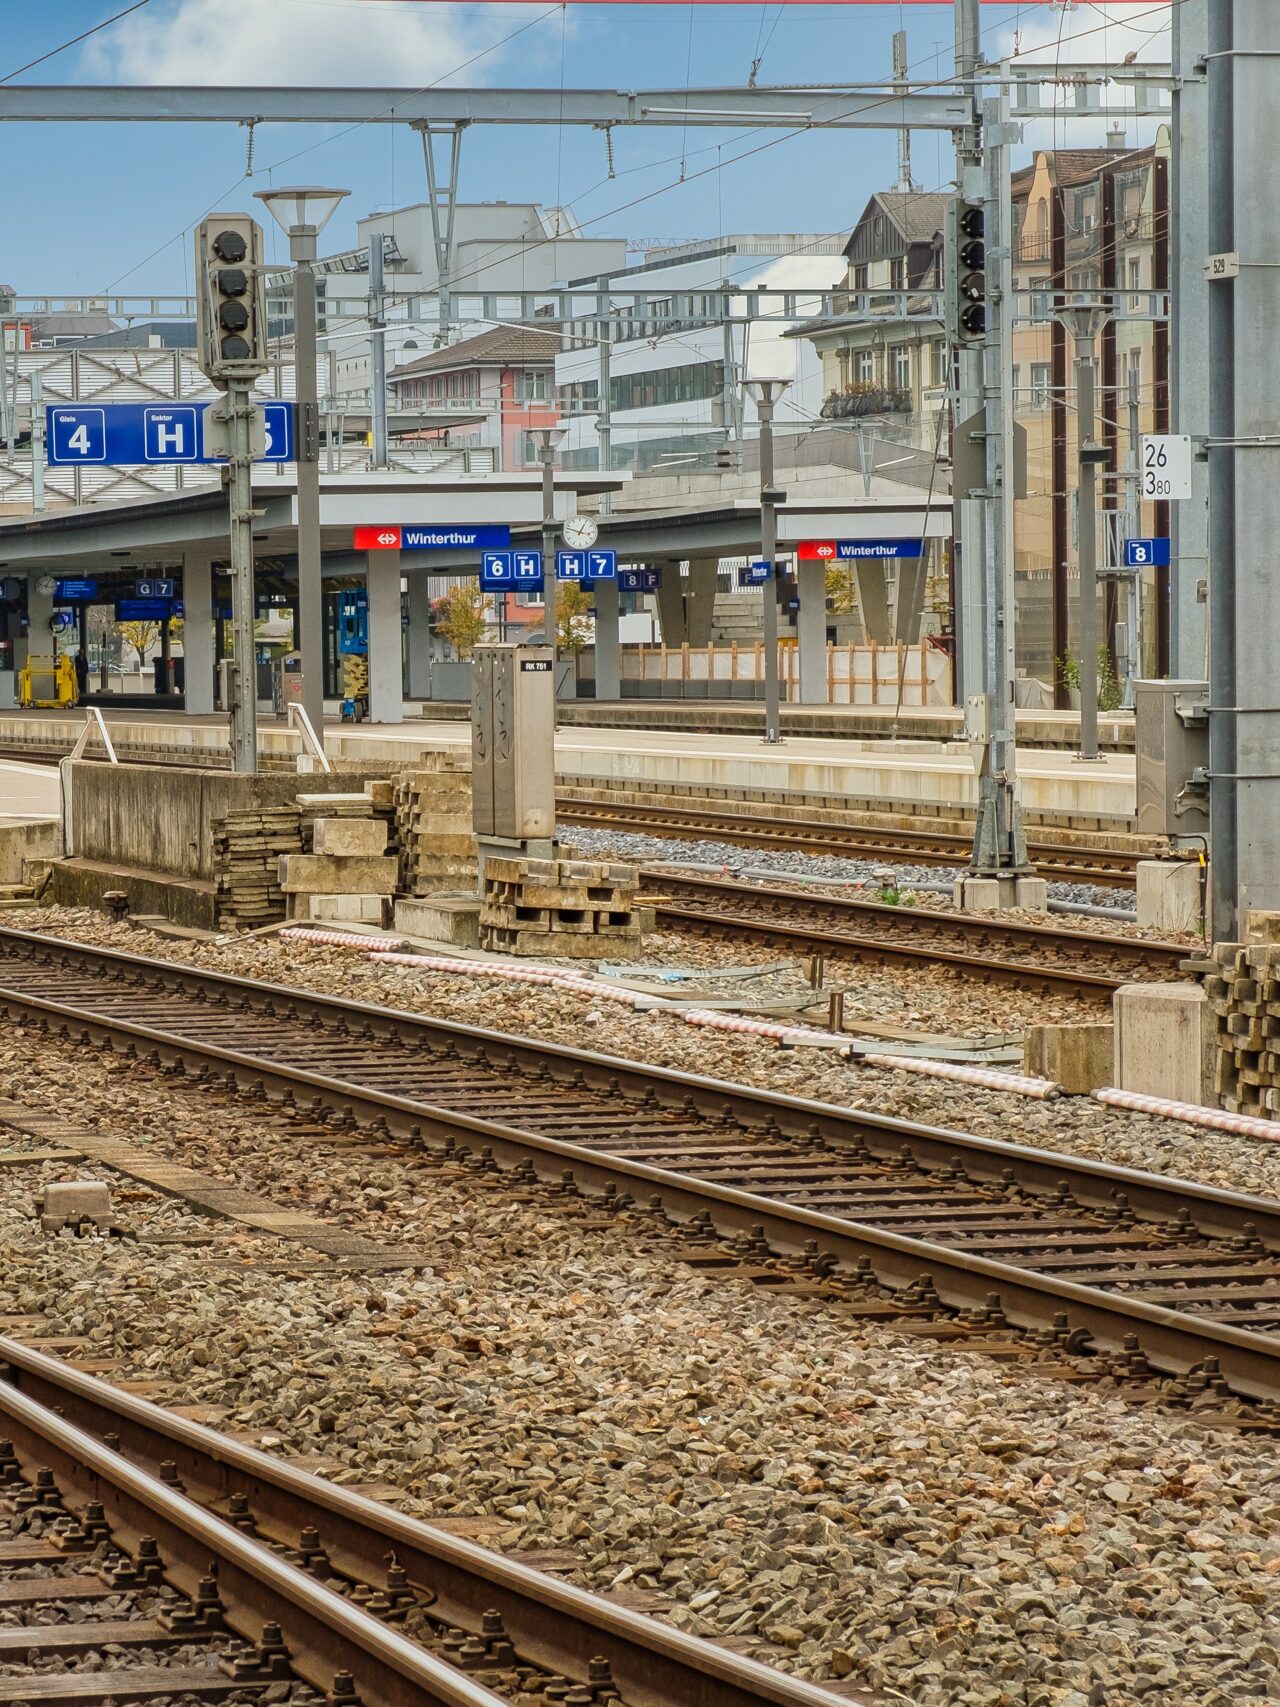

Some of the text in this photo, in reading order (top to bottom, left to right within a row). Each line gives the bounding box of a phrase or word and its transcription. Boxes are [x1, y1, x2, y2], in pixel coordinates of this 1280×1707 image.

[1213, 258, 1225, 274] 529
[59, 414, 173, 423] Gleis Sektor
[68, 423, 184, 455] 4 H
[1145, 443, 1167, 468] 26
[406, 532, 477, 545] Winterthur
[840, 545, 898, 556] Winterthur
[1135, 546, 1147, 562] 8
[491, 559, 534, 577] 6 H
[565, 558, 607, 575] H 7
[628, 575, 657, 586] 8 F
[744, 573, 752, 584] F
[140, 584, 168, 594] G 7
[525, 662, 547, 671] RK 751
